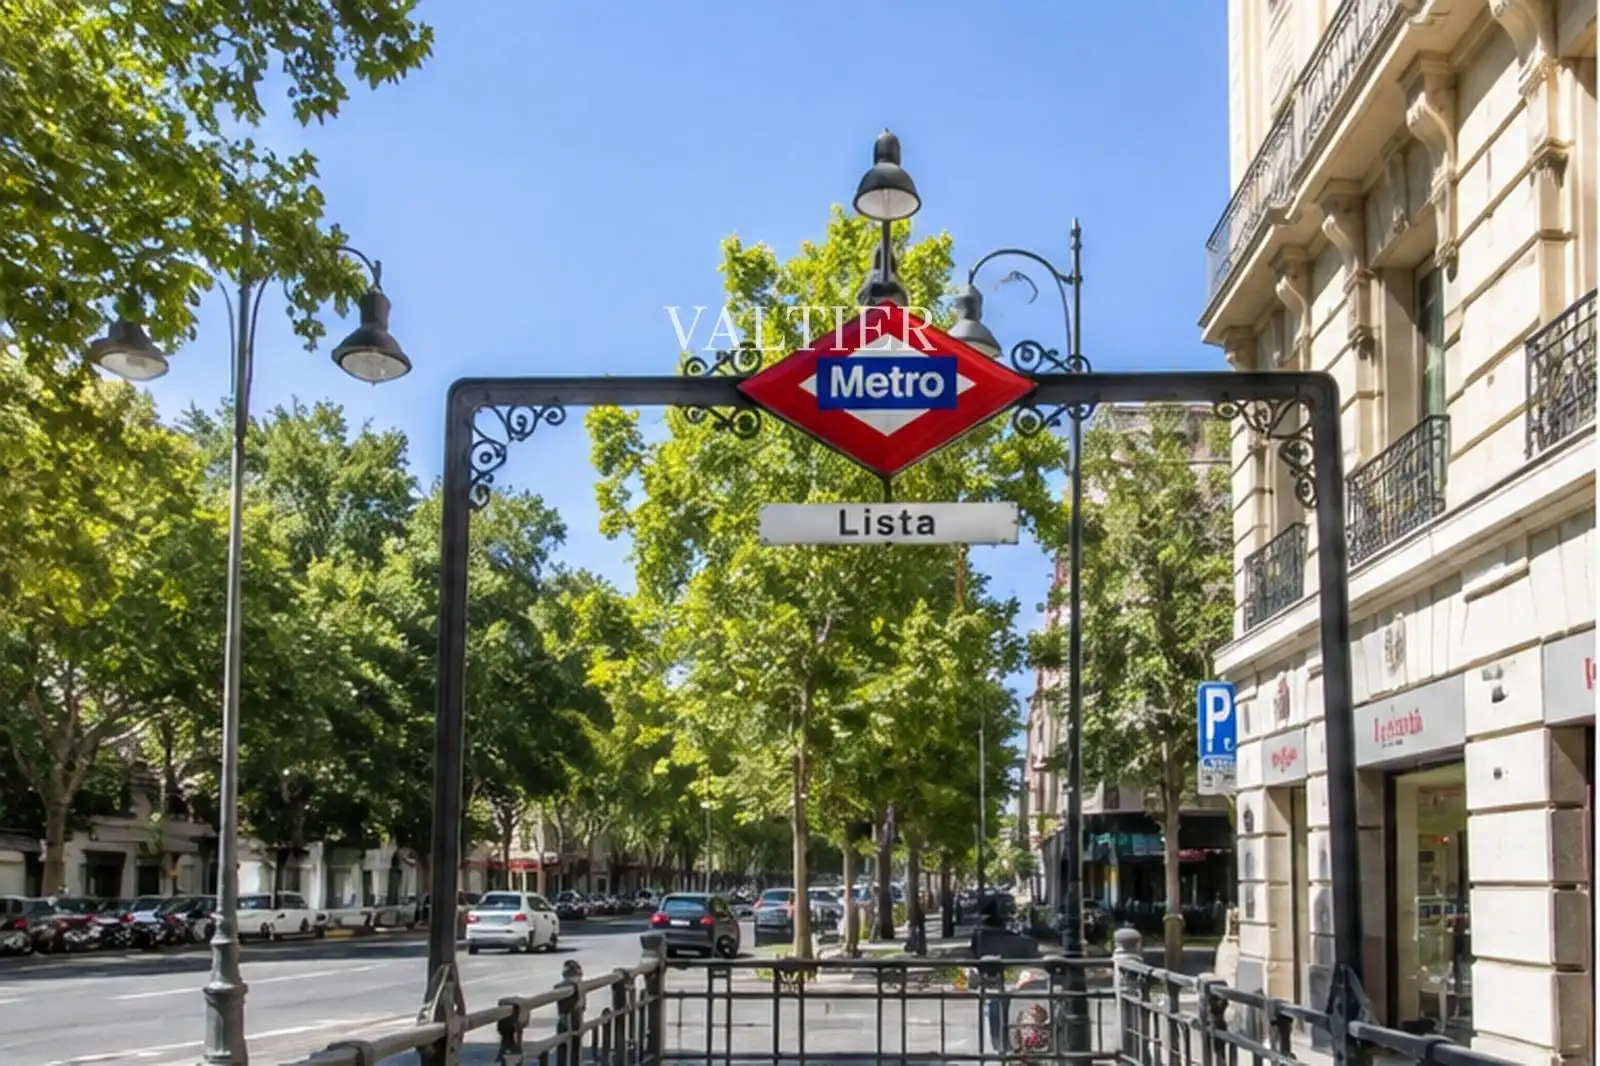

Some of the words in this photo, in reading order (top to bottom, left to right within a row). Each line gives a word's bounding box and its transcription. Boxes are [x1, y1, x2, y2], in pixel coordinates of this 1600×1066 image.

[830, 365, 945, 399] Metro
[839, 508, 936, 536] Lista
[1206, 688, 1232, 742] P
